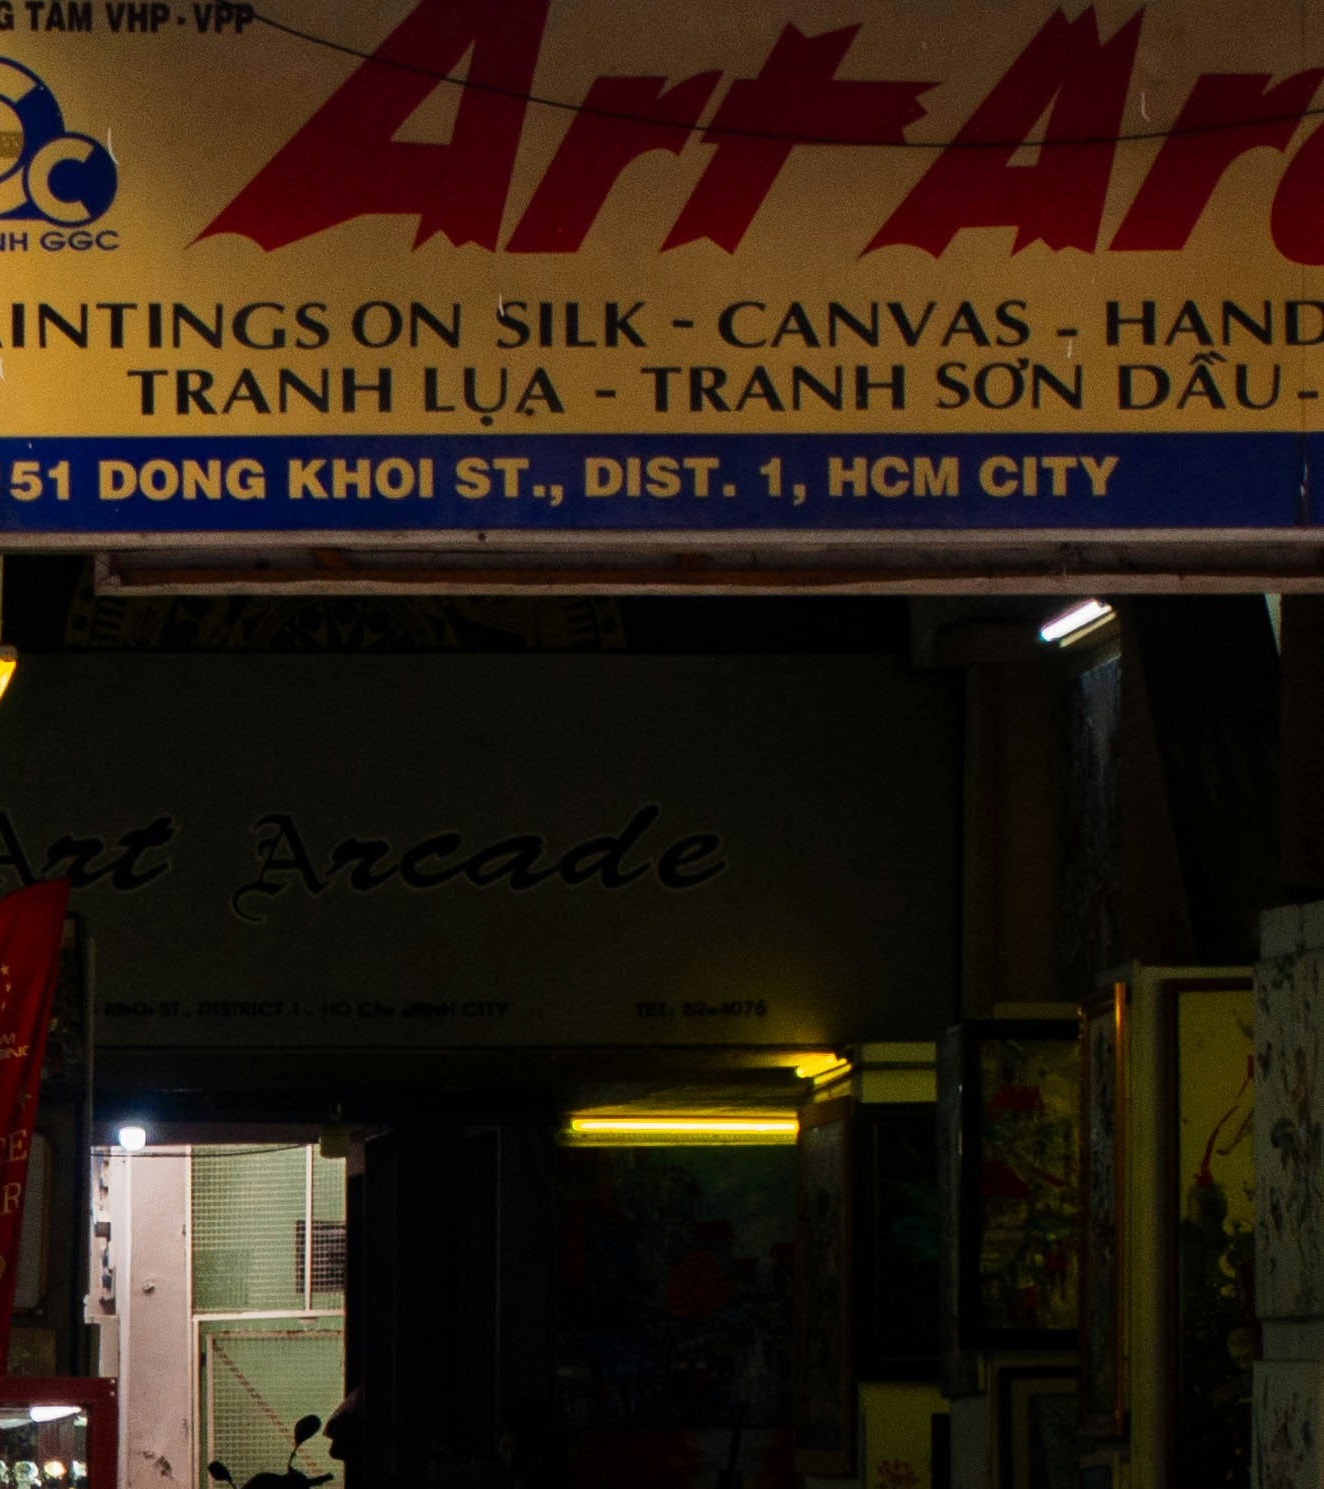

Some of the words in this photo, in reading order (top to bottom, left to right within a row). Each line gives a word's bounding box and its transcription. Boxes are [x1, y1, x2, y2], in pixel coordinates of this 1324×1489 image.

[106, 1, 169, 32] VHP
[195, 1, 254, 32] VPP
[185, 0, 943, 254] Art
[40, 230, 119, 251] GGC
[352, 301, 460, 348] ON
[496, 301, 646, 349] SILK
[718, 300, 1030, 348] CANVAS
[128, 368, 392, 414] TRANH
[424, 368, 564, 424] LỤA
[641, 365, 905, 412] TRANH
[936, 357, 1082, 409] SƠN
[99, 460, 264, 500] DONG
[288, 459, 432, 499] KHOI
[586, 457, 734, 496] DIST.
[761, 457, 806, 505] 1,
[828, 457, 959, 496] HCM
[980, 456, 1118, 496] CITY
[231, 804, 726, 922] Arcade
